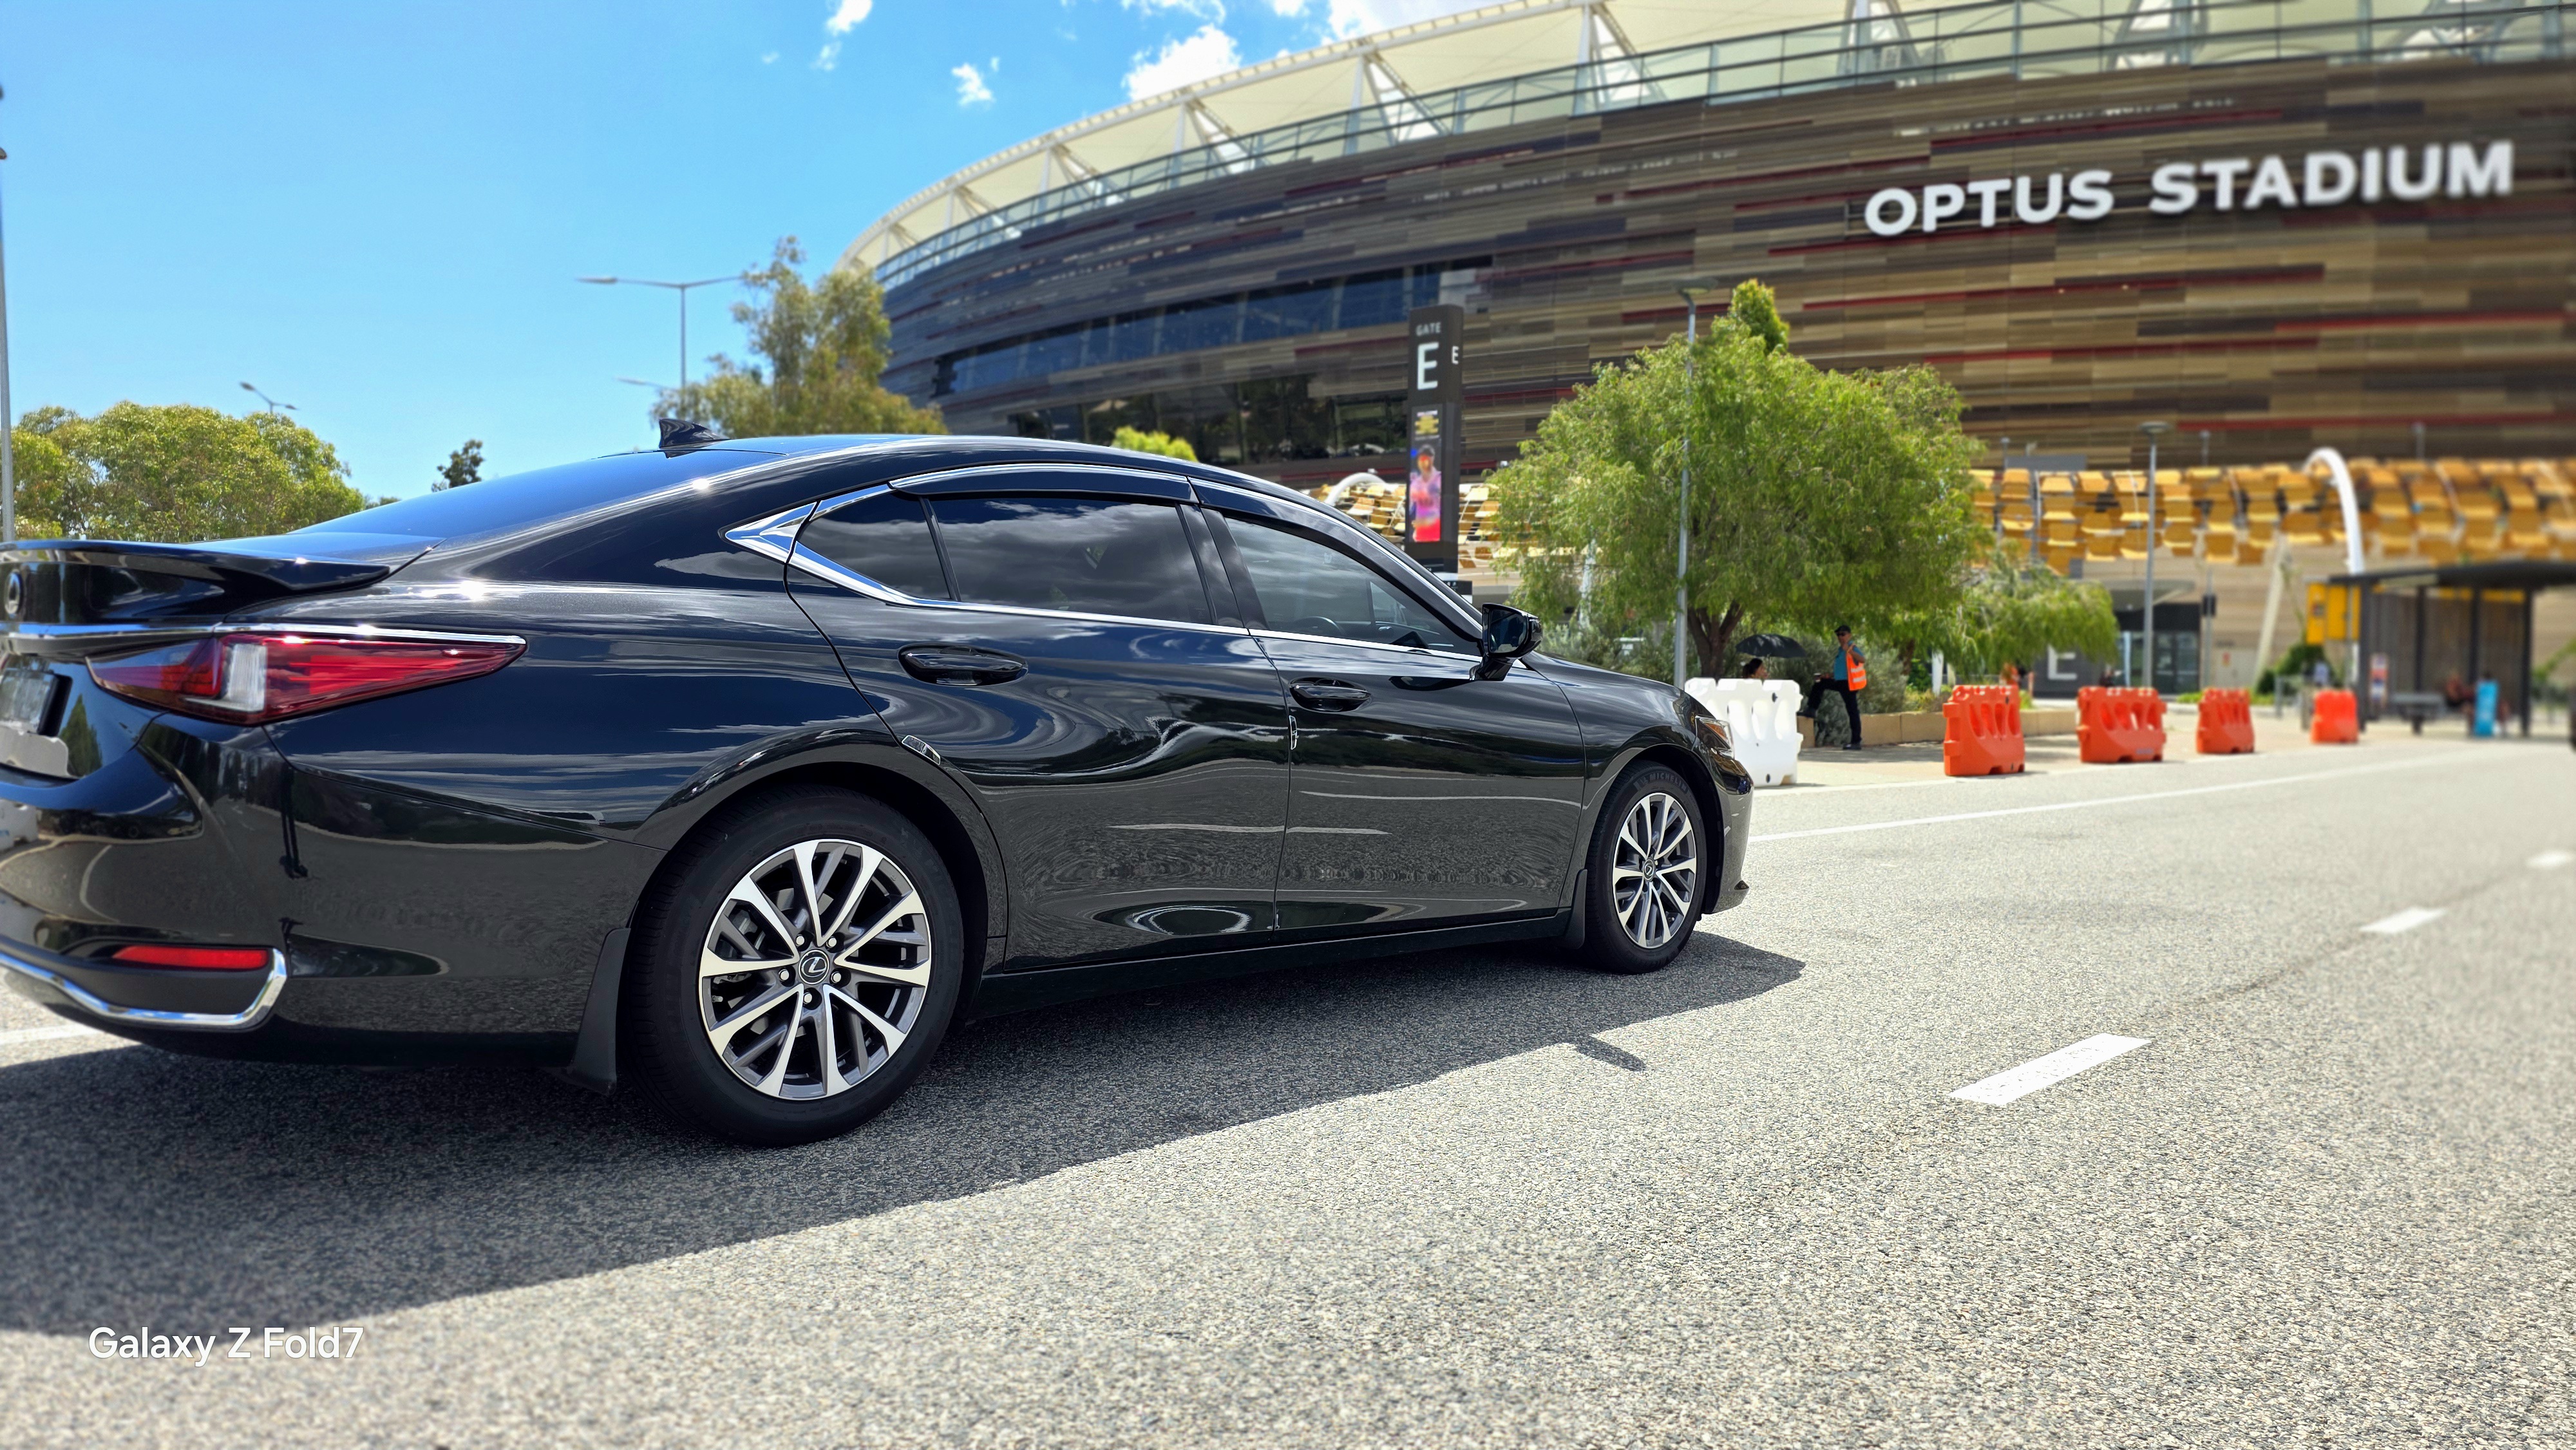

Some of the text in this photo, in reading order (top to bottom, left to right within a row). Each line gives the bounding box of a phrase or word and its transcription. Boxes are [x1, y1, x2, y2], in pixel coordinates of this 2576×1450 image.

[1864, 140, 2514, 236] OPTUS STADIUM
[1416, 323, 1441, 336] GATE
[1452, 345, 1459, 365] E
[1417, 342, 1439, 390] E
[1650, 773, 1687, 792] MICHELIN
